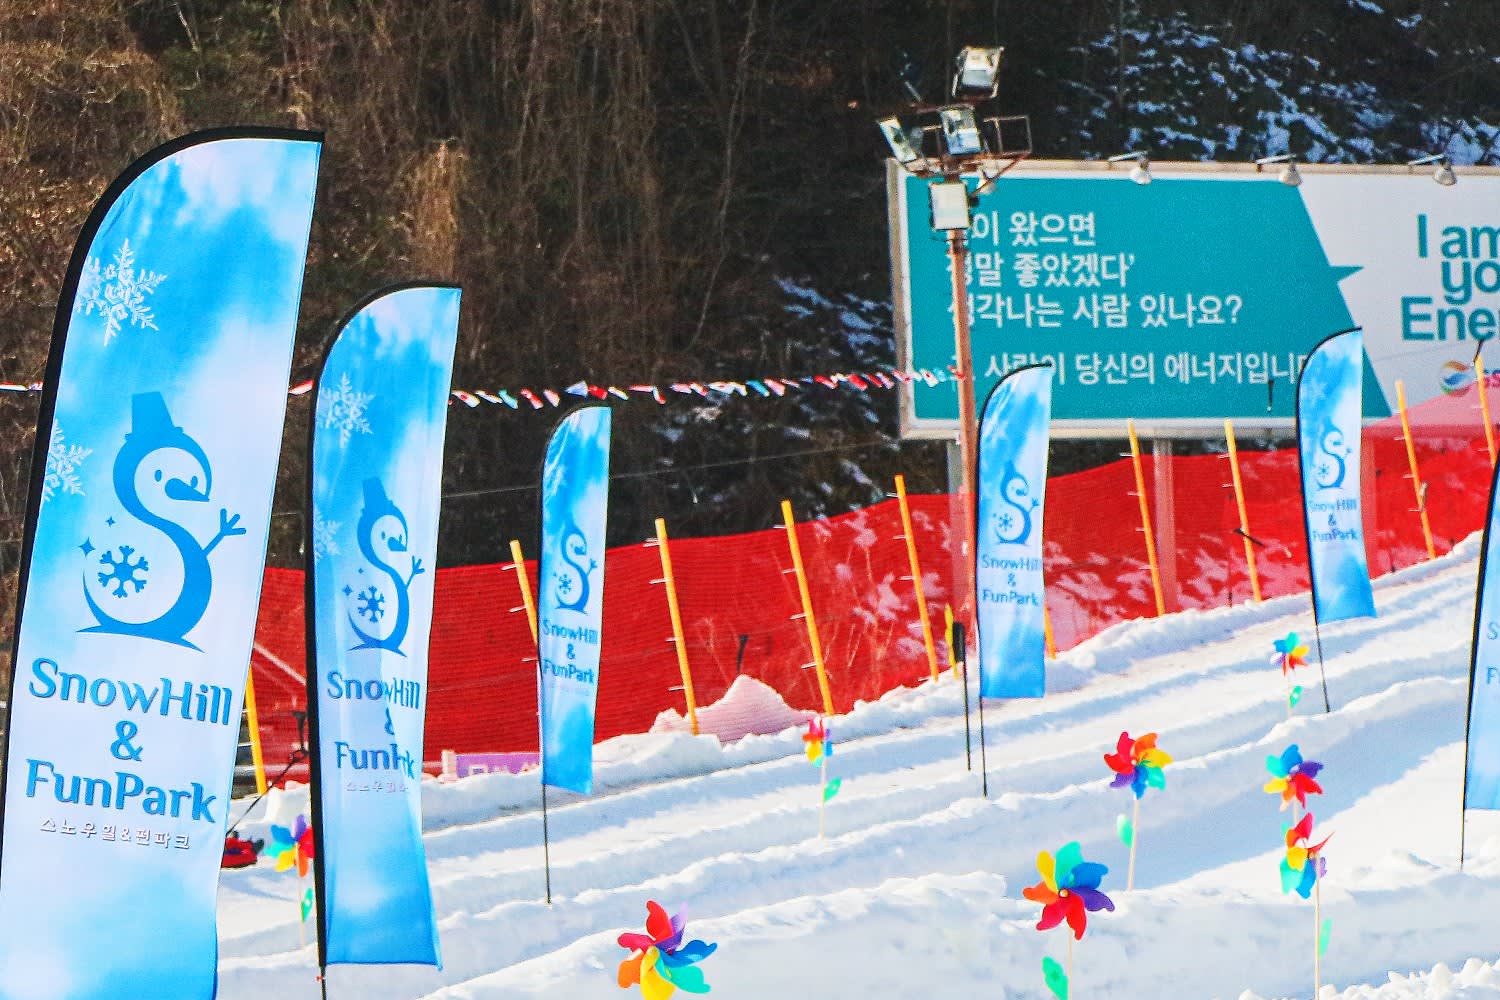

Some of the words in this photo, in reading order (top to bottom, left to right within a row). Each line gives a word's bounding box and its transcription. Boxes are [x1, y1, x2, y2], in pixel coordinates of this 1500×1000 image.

[1009, 211, 1097, 247] 왔으면
[1417, 213, 1429, 259] I
[1073, 293, 1131, 329] 사람
[1140, 293, 1244, 329] 있나요?
[1075, 352, 1156, 385] 당신의
[1008, 572, 1017, 587] &
[982, 589, 1039, 607] FunPark
[542, 619, 599, 645] SnowHill
[565, 643, 576, 660] &
[542, 660, 595, 684] FunPark
[28, 657, 233, 726] SnowHill
[109, 719, 144, 762] &
[25, 758, 216, 824] FunPark
